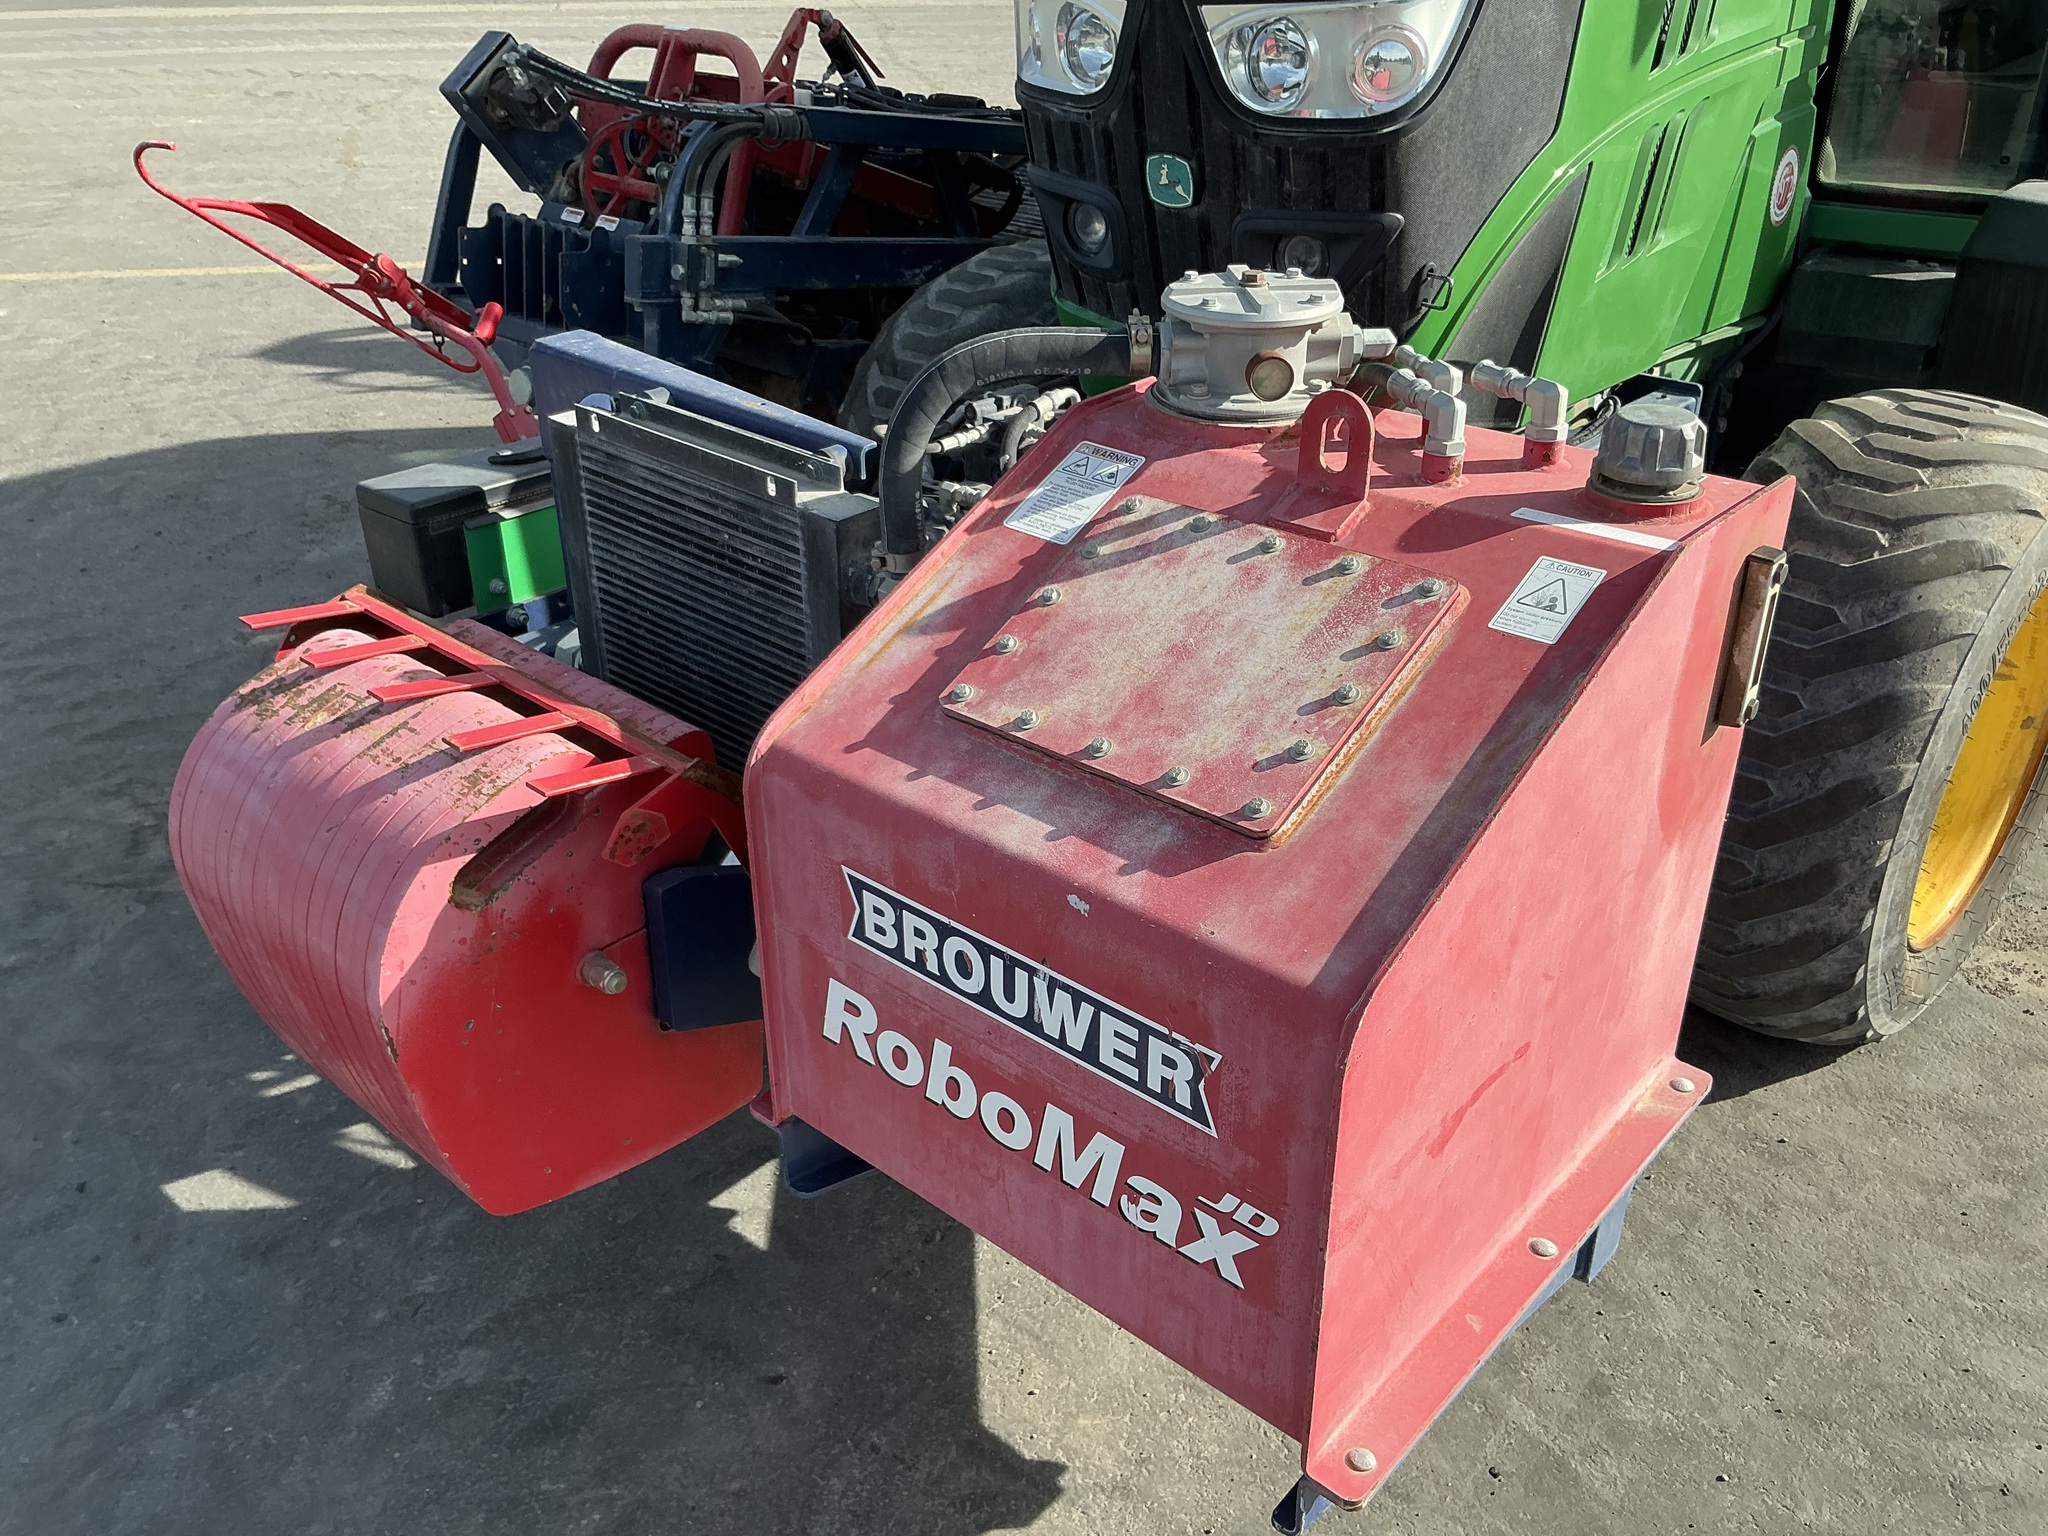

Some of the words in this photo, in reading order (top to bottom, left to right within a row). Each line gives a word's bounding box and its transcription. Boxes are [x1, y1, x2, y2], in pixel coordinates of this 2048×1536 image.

[1091, 447, 1139, 466] WARNING
[1555, 564, 1593, 578] CAUTION
[862, 889, 1194, 1110] BROUWER
[822, 977, 1259, 1290] RoboMax
[1198, 1192, 1280, 1238] JD
